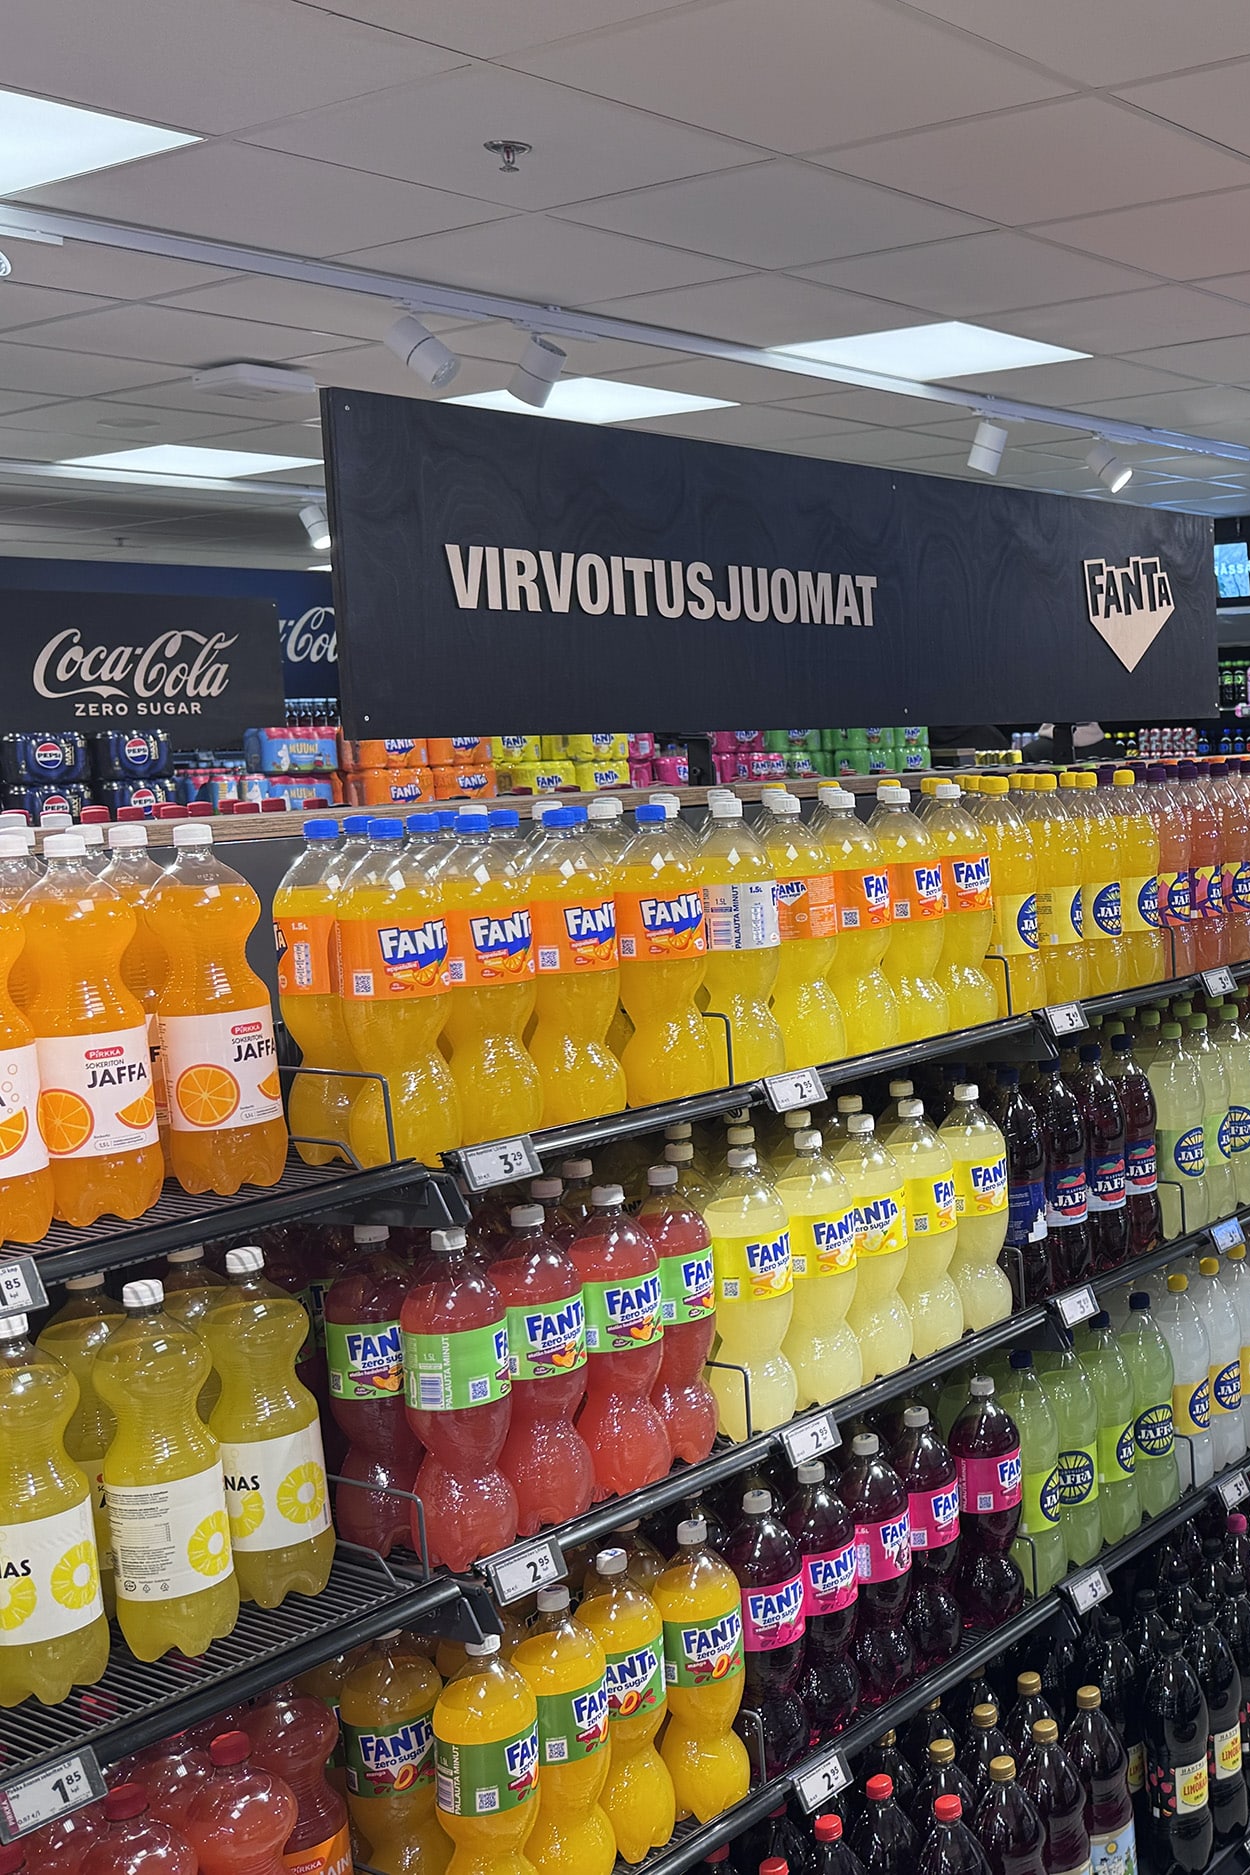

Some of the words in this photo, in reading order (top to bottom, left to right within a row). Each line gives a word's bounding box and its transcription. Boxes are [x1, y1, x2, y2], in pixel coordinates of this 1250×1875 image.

[444, 543, 878, 628] VIRVOITUSJUOMAT
[1083, 556, 1174, 618] FANTA
[32, 627, 240, 699] Coca-Cola
[74, 702, 129, 717] ZERO
[136, 701, 203, 716] SUGAR
[391, 784, 422, 802] FANTA
[458, 774, 488, 790] FANTA
[953, 857, 990, 883] FANT
[731, 885, 740, 910] MINUT
[470, 909, 532, 947] FANT
[733, 911, 742, 949] PALAUTA
[87, 1062, 147, 1089] JAFFA
[794, 1082, 807, 1100] 2
[499, 1153, 515, 1174] 3
[971, 1157, 1007, 1188] FANT
[853, 1199, 898, 1226] ANTA
[813, 1212, 854, 1246] FANT
[746, 1231, 790, 1268] FANT
[5, 1278, 21, 1290] 85
[620, 1310, 640, 1321] zero
[346, 1326, 401, 1361] FAN
[541, 1338, 562, 1348] zero
[361, 1358, 385, 1369] zero
[526, 1561, 542, 1583] 2
[538, 1555, 550, 1567] 95
[809, 1545, 857, 1585] FANT
[762, 1614, 781, 1625] zero
[606, 1650, 658, 1685] ANTA
[697, 1649, 716, 1661] zero
[624, 1674, 649, 1691] sugar
[374, 1757, 397, 1770] zero
[399, 1745, 425, 1763] sugar
[452, 1745, 460, 1773] MINUT
[51, 1778, 70, 1803] 1
[65, 1770, 82, 1786] 85
[822, 1772, 834, 1791] 2
